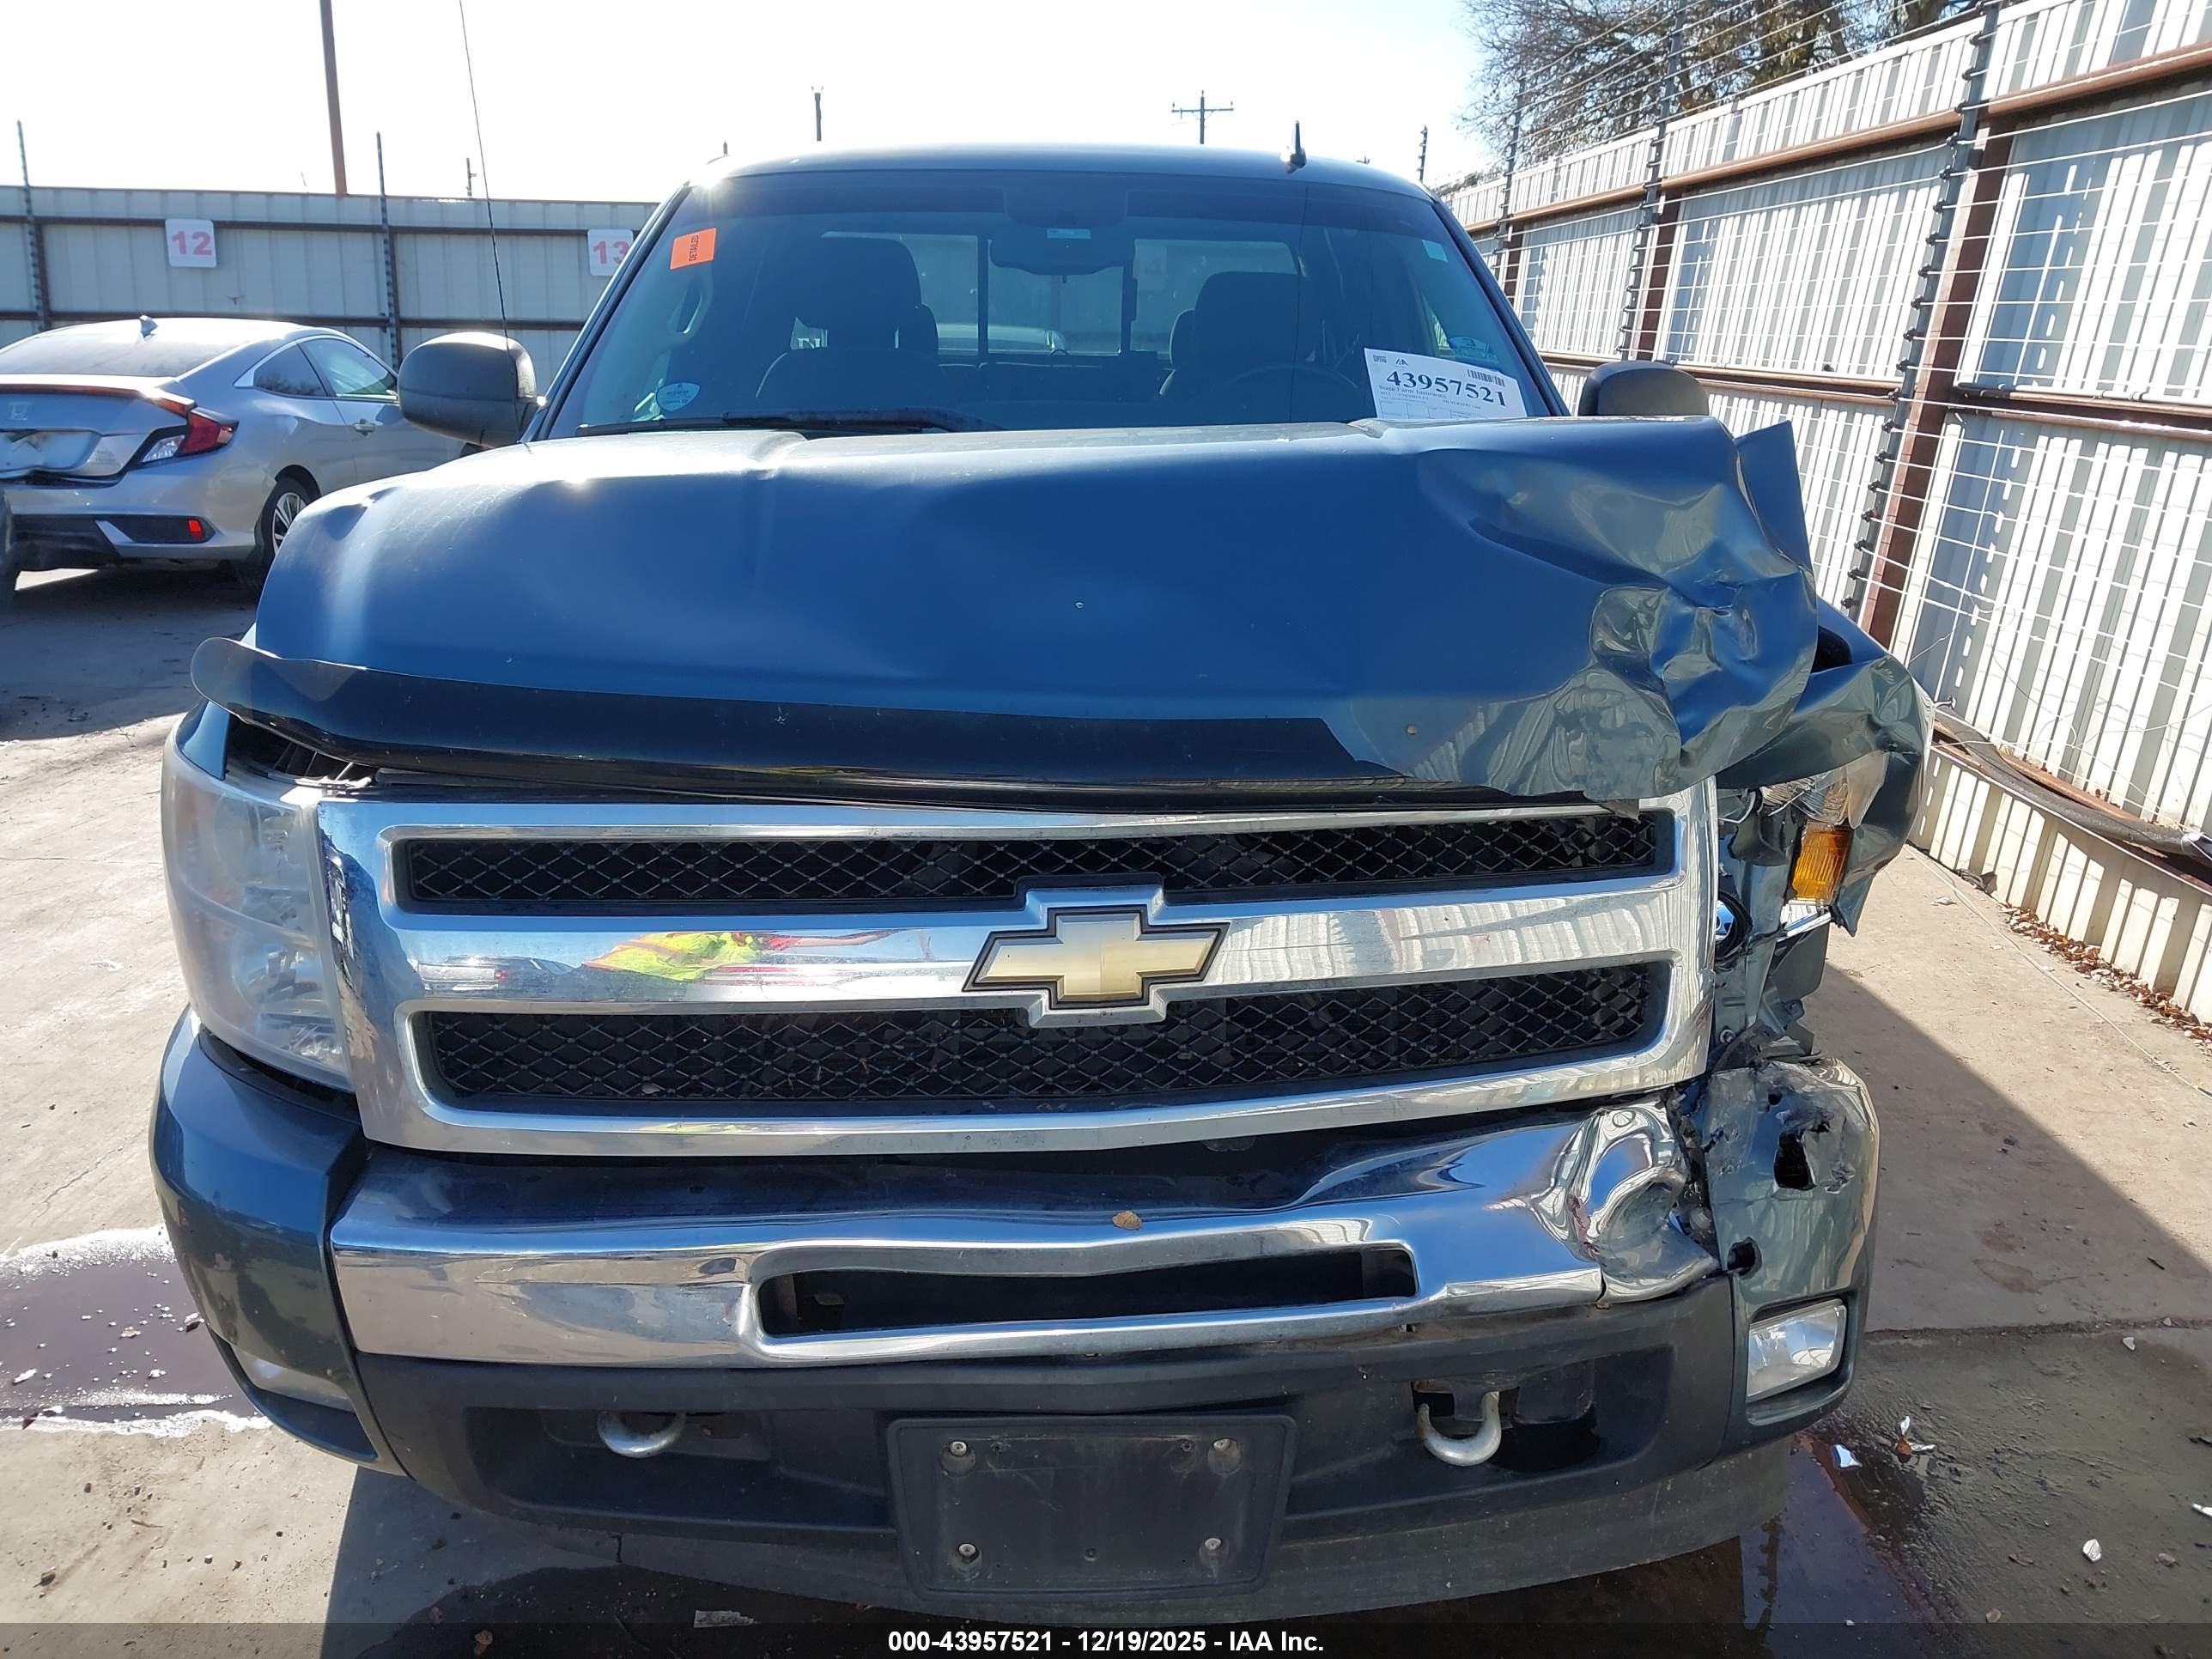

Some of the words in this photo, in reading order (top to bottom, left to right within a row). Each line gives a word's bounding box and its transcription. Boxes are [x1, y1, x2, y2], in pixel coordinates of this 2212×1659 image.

[172, 230, 212, 255] 12
[689, 234, 699, 262] DETAILED
[1386, 370, 1507, 407] 43957521
